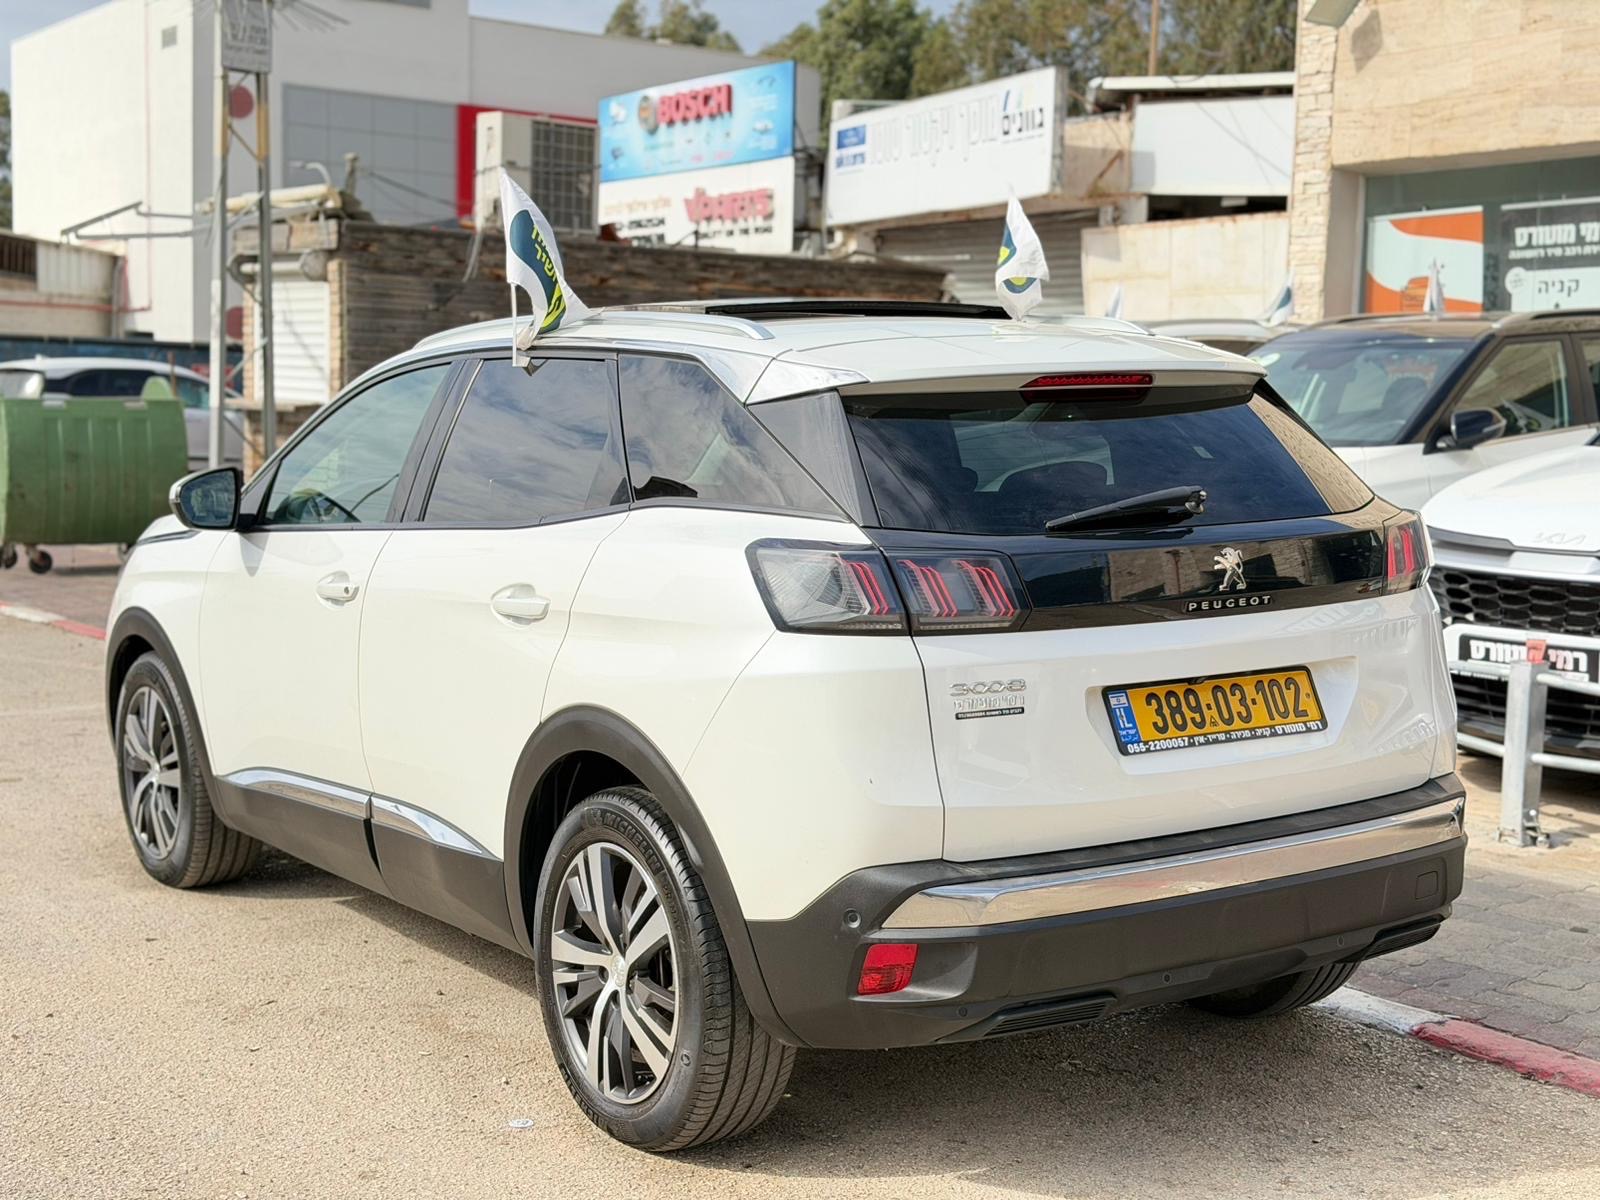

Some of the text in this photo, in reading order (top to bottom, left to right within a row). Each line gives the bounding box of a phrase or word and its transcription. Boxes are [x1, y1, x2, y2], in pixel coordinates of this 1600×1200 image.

[657, 84, 733, 125] BOSCH
[1002, 108, 1045, 136] גוונים
[1514, 221, 1600, 247] מי מוטורס
[1538, 278, 1580, 297] קניה
[1188, 595, 1271, 611] PEUGEOT
[1469, 638, 1588, 673] רמי וטורס
[949, 678, 1026, 697] 3008
[1115, 707, 1134, 729] IL
[1306, 720, 1324, 733] רמי
[1276, 722, 1306, 735] מוטורס
[1127, 736, 1190, 754] 055-2200057
[603, 812, 664, 876] MICHELIN
